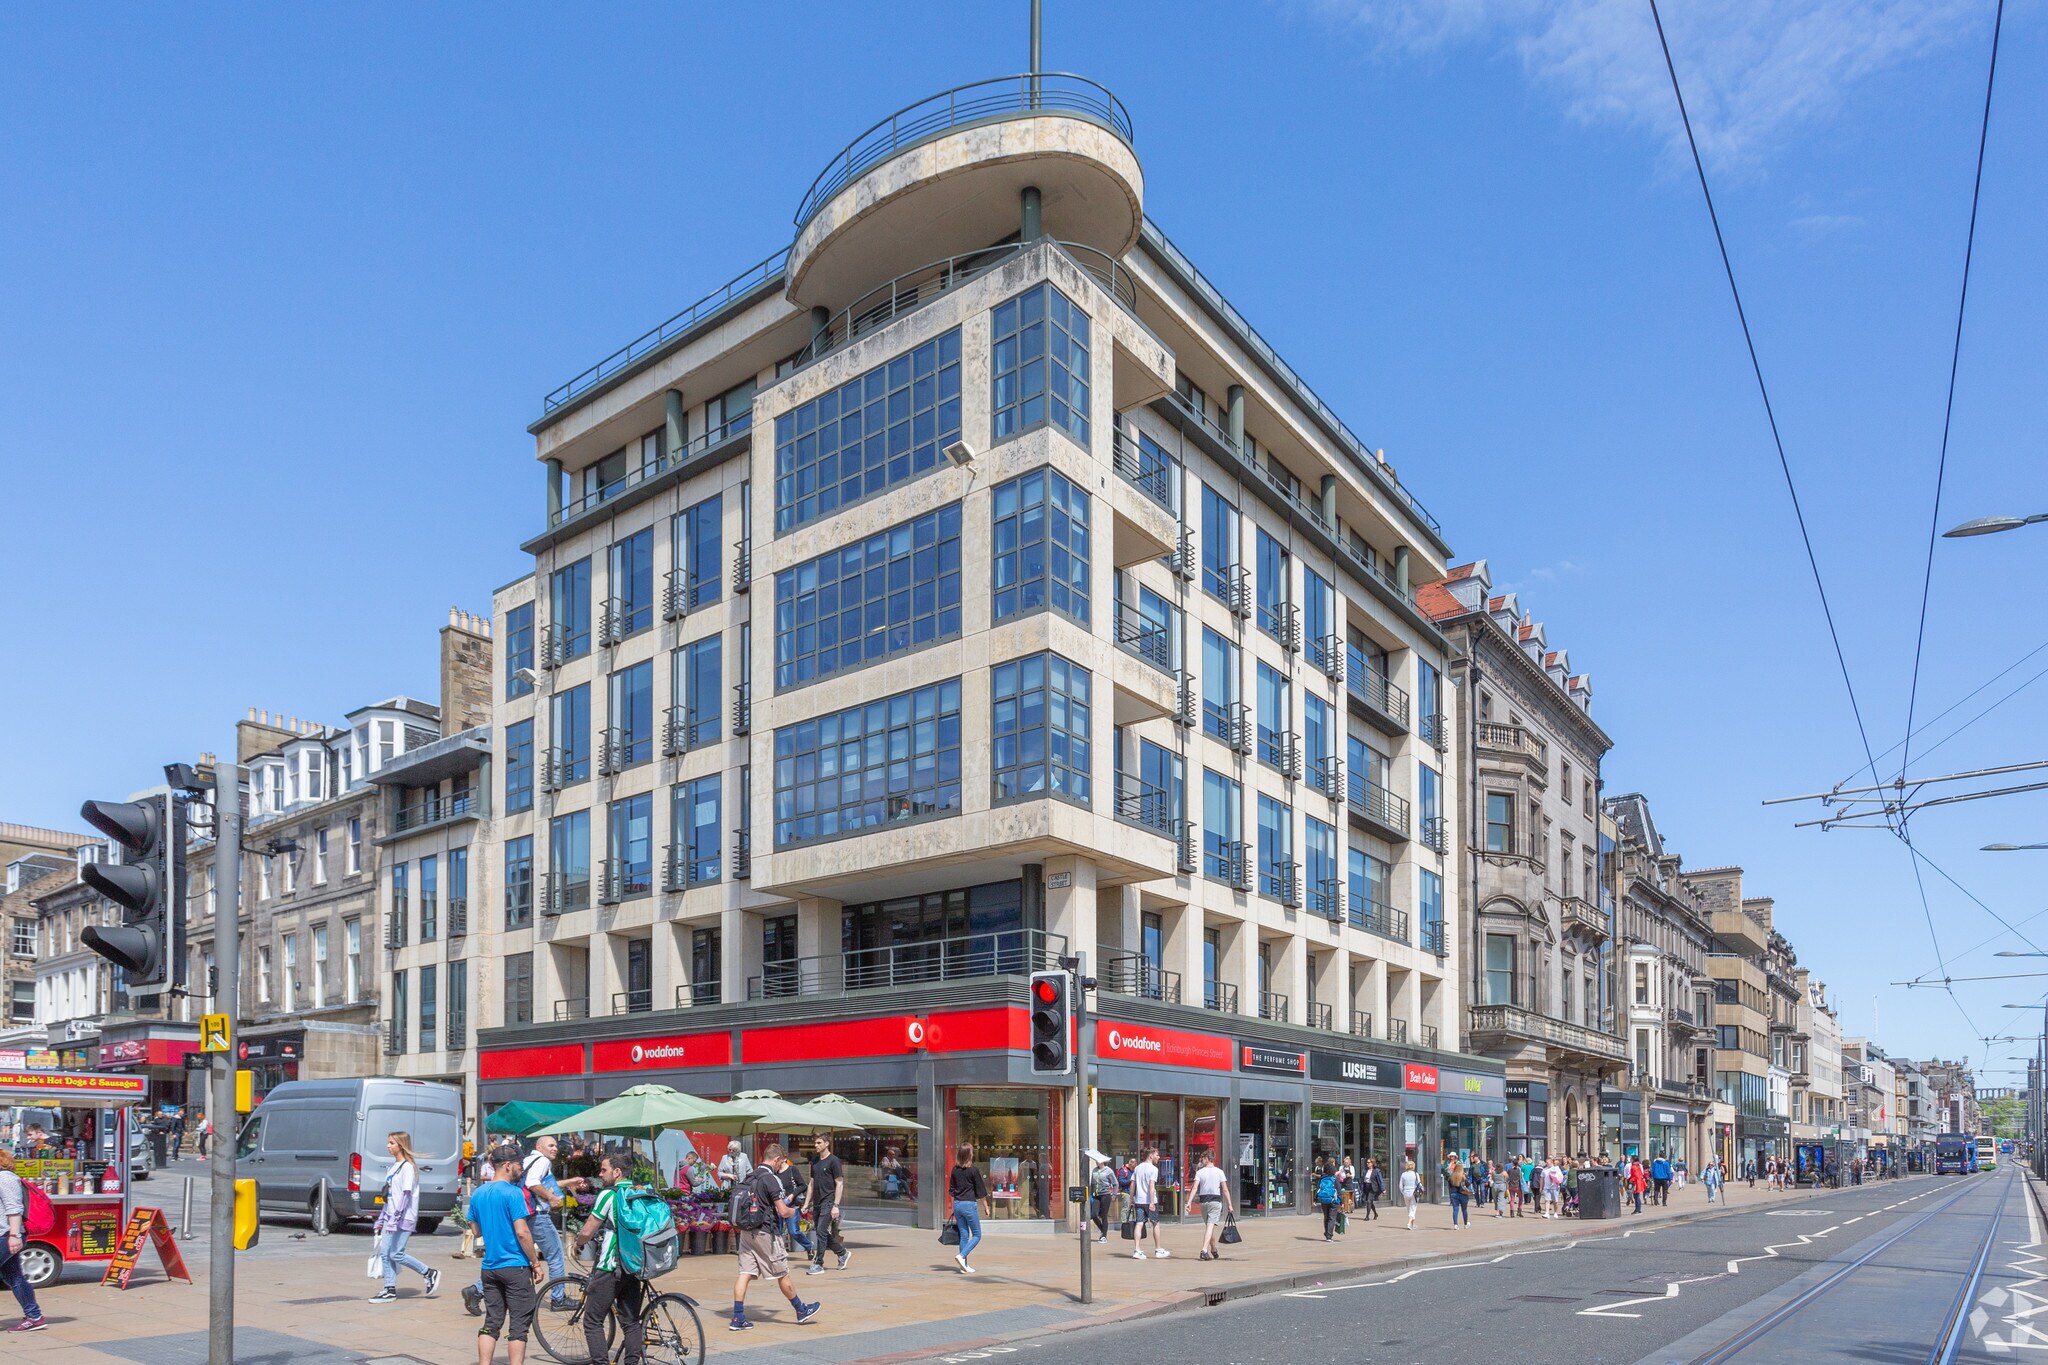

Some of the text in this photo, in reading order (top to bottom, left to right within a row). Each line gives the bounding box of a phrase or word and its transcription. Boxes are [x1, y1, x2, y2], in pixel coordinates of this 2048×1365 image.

[1122, 1036, 1160, 1051] vodafone
[1167, 1043, 1224, 1058] Edinburgh Princes Street
[644, 1045, 684, 1058] vodafone
[1264, 1055, 1285, 1064] PERFUME
[1287, 1058, 1300, 1066] SHOP
[1342, 1062, 1366, 1079] LUSH
[16, 1075, 44, 1084] Jack's
[46, 1077, 62, 1085] Hot
[65, 1077, 87, 1087] Dogs
[98, 1079, 138, 1088] Sausages
